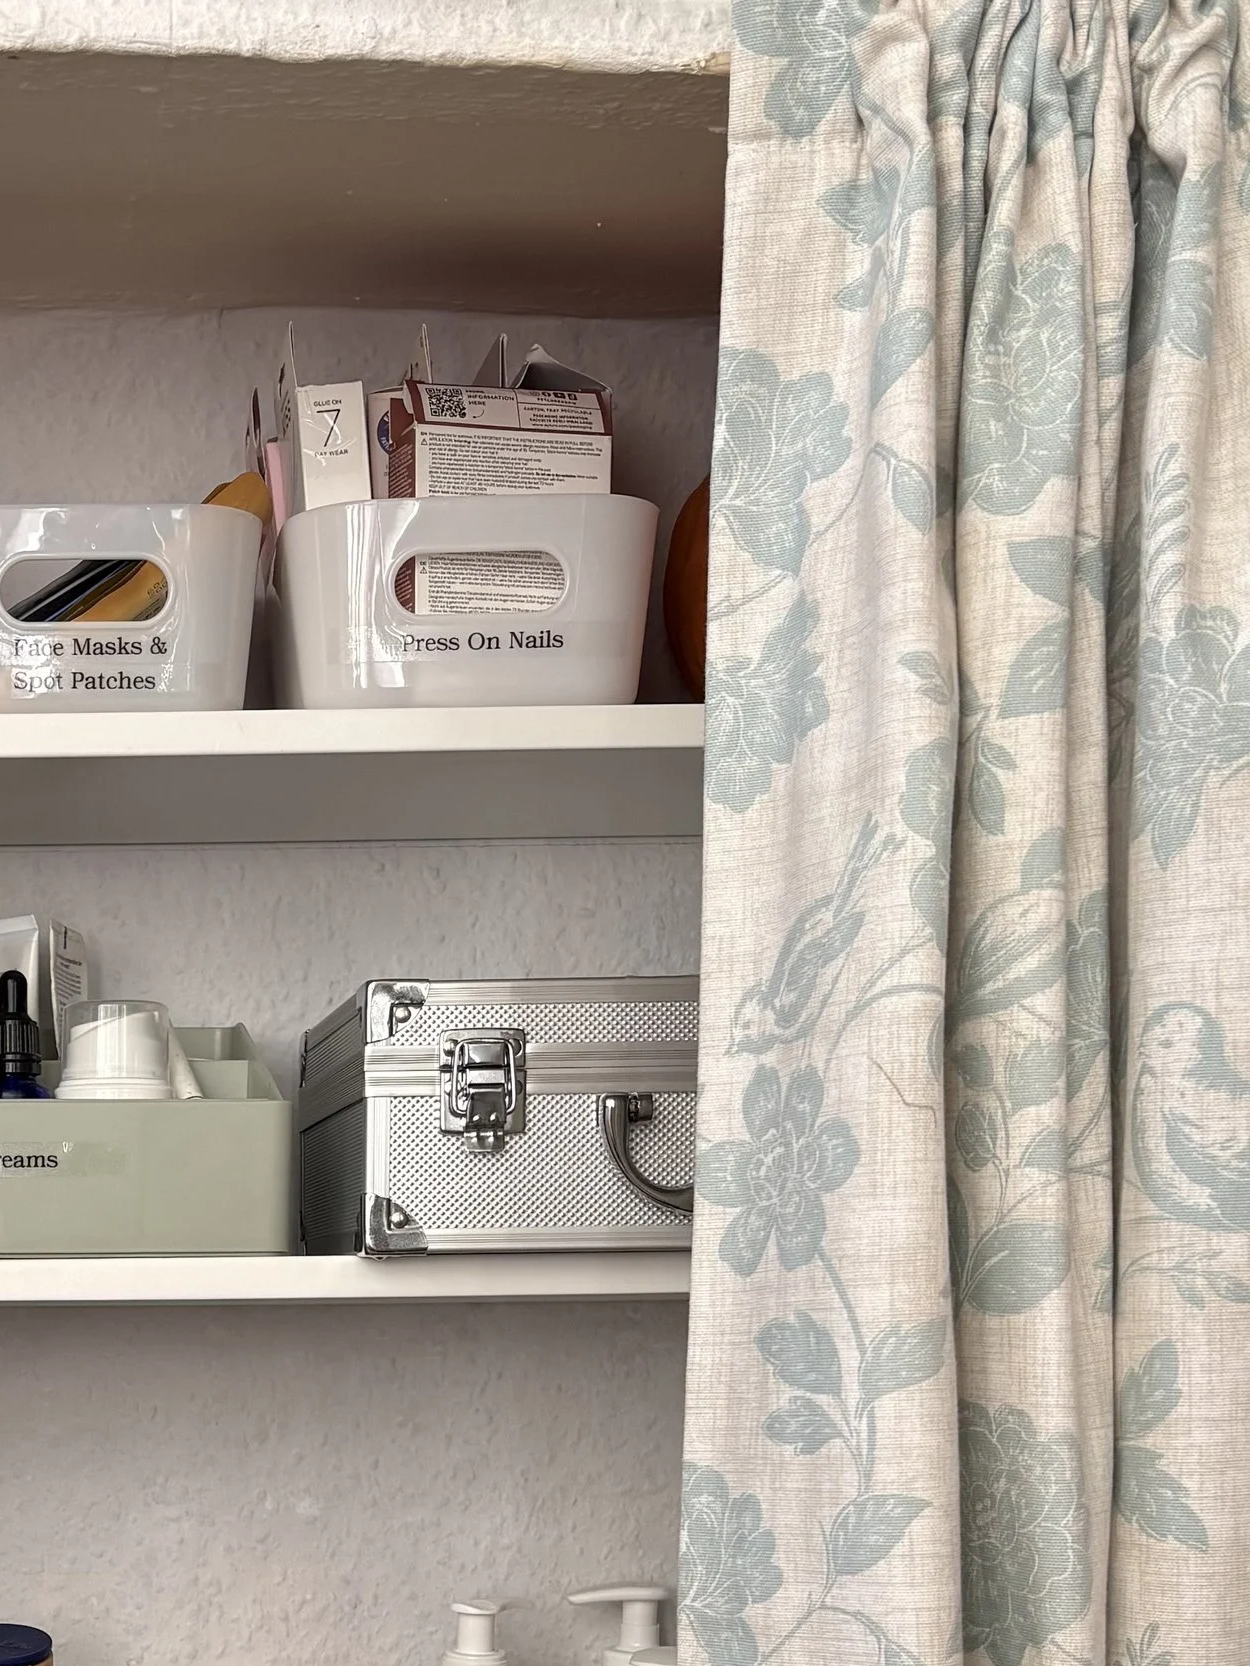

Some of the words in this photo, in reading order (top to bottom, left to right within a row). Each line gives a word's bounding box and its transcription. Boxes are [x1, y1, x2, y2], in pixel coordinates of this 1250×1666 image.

[317, 409, 341, 447] 7
[13, 639, 64, 656] Face
[72, 637, 143, 656] Masks
[150, 636, 168, 654] &
[403, 635, 460, 652] Press
[468, 632, 501, 650] On
[510, 630, 564, 649] Nails
[13, 671, 63, 692] Spot
[71, 671, 156, 690] Patches
